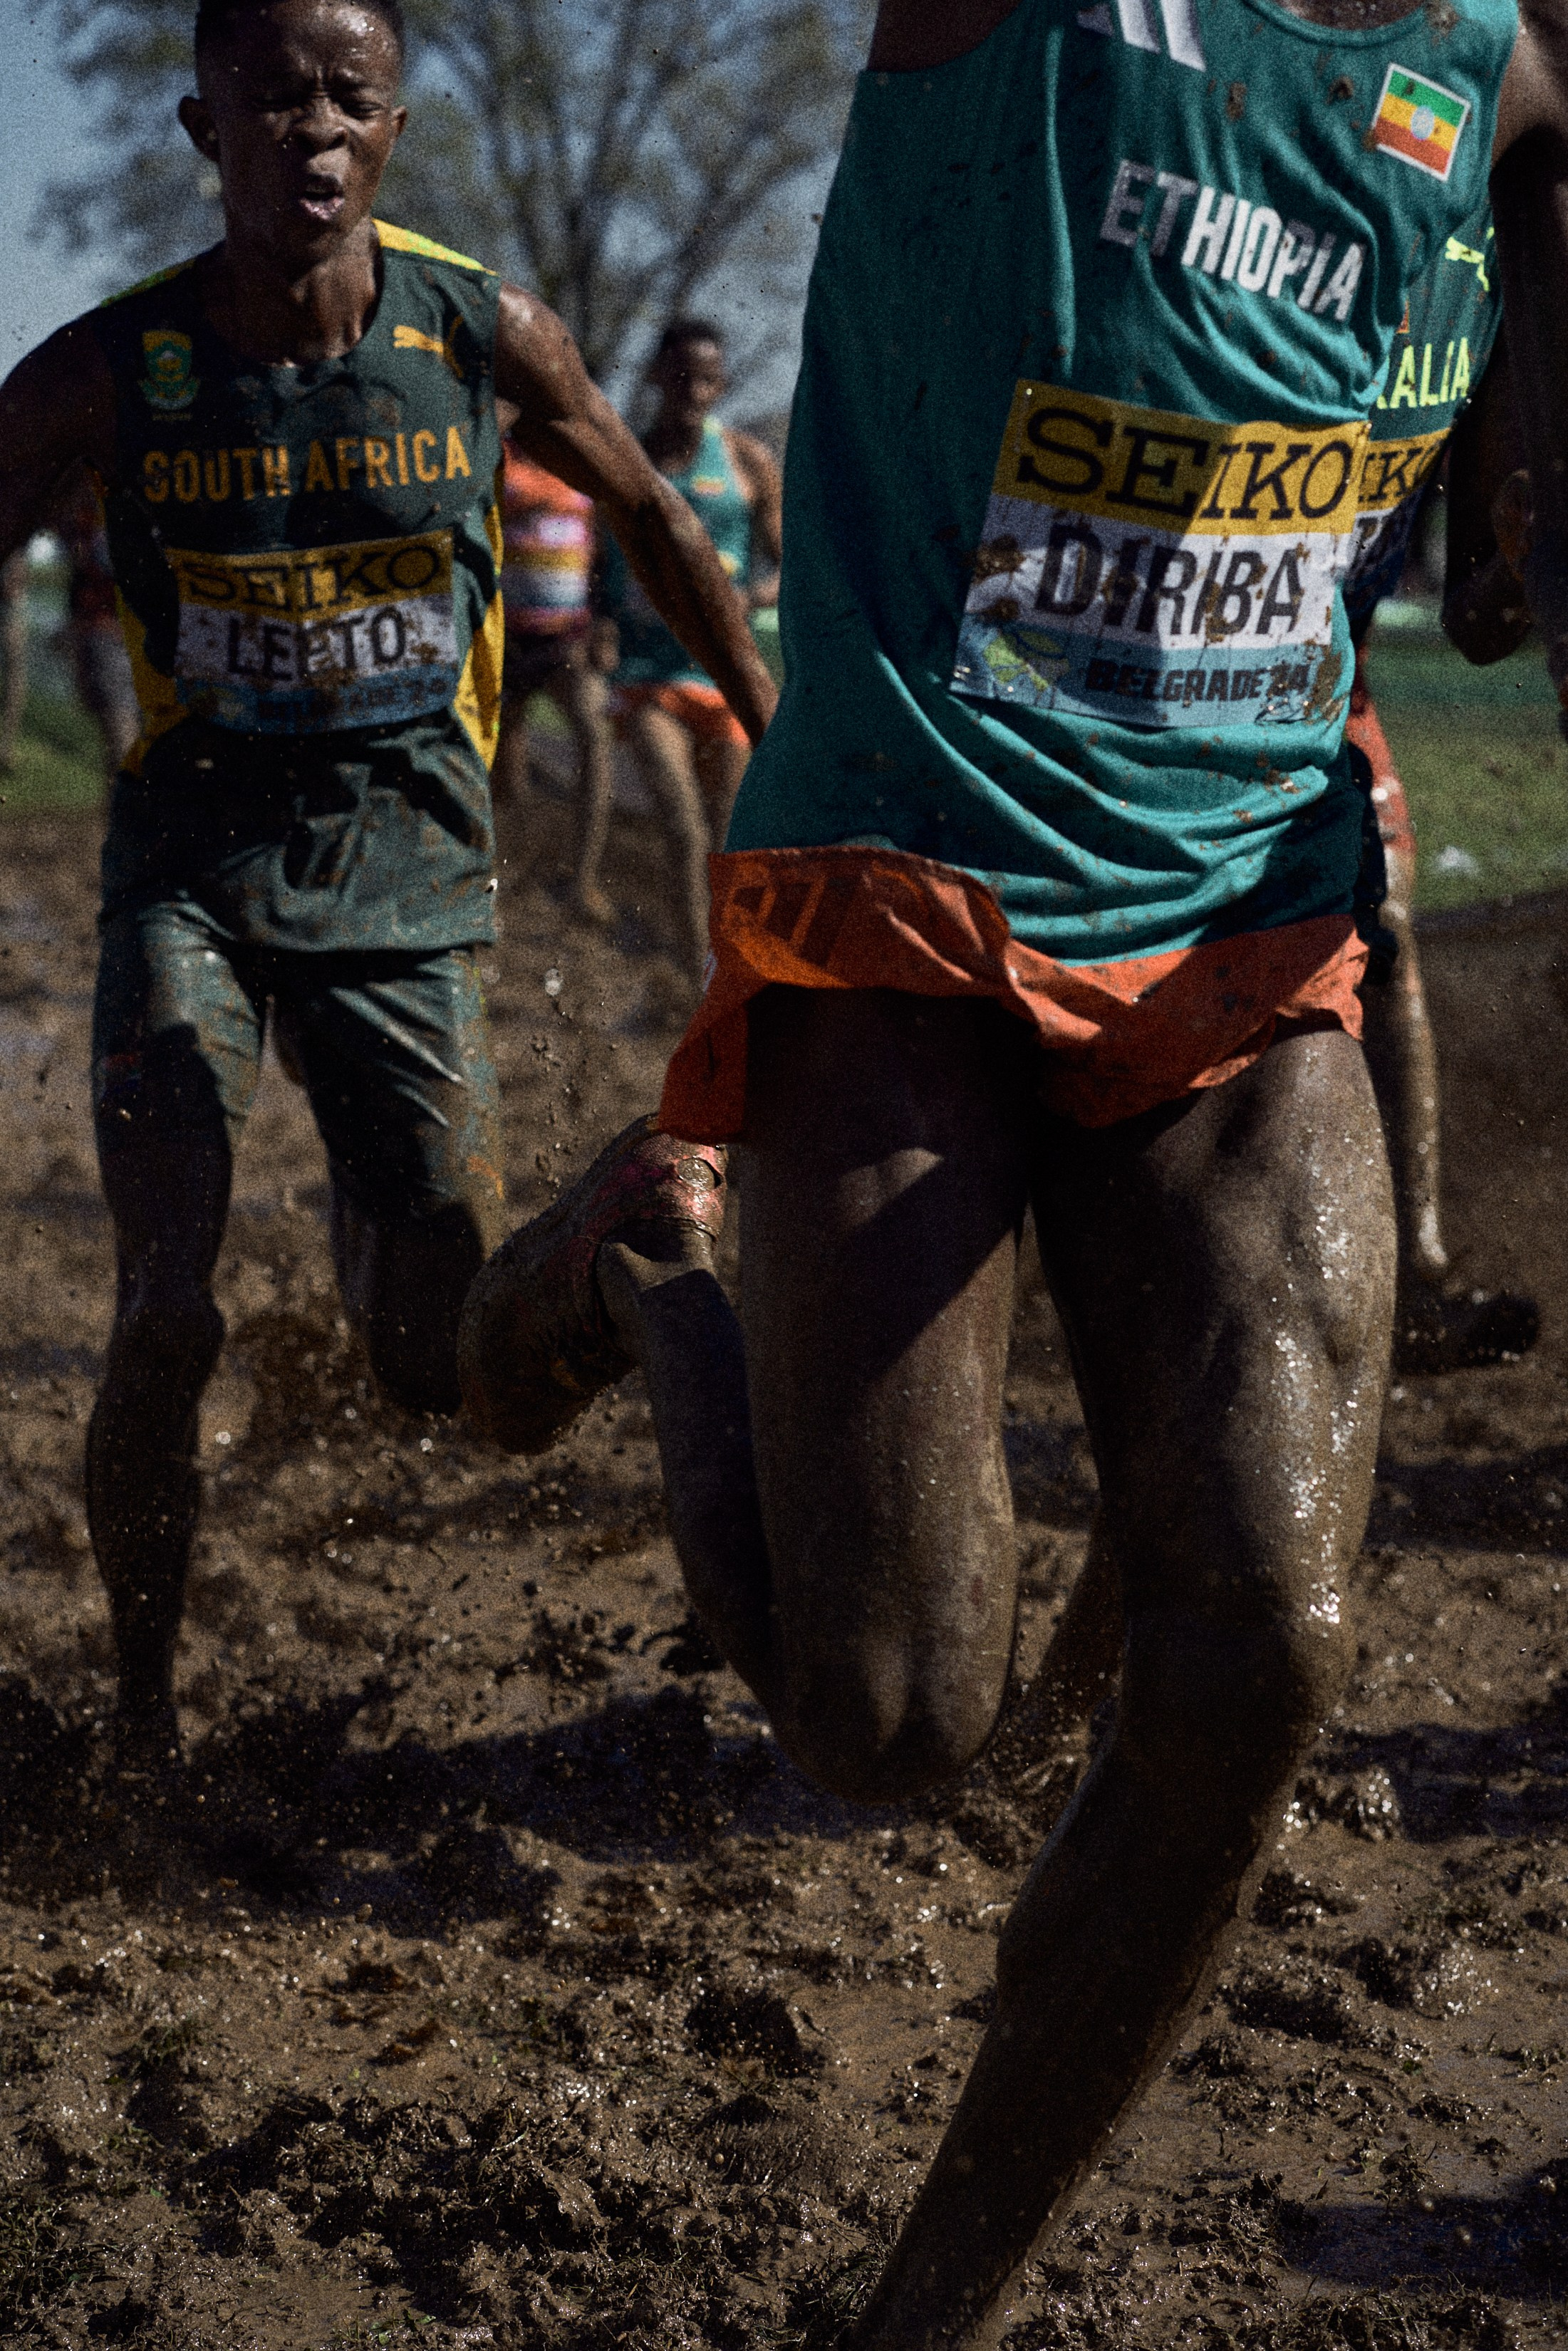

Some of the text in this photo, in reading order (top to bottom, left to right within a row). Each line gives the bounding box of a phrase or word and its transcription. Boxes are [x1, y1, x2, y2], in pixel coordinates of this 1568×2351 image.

[1099, 159, 1366, 321] ETHIOPIA
[1376, 337, 1471, 410] ALIA
[142, 426, 472, 502] SOUTH AFRICA
[1017, 408, 1354, 520] SEIKO
[184, 546, 439, 612] SEIKO
[1035, 524, 1303, 635] DIRIBA
